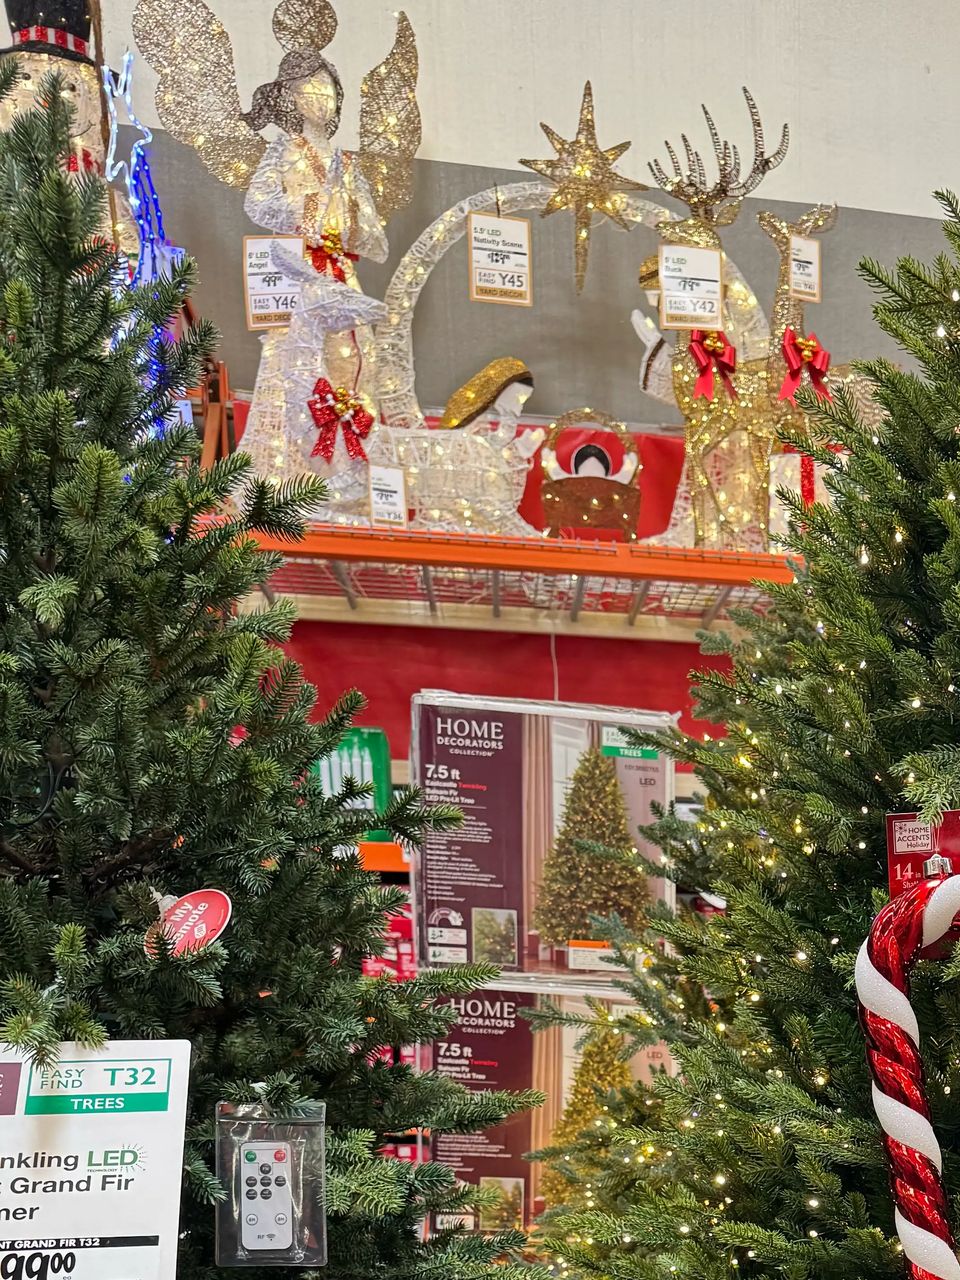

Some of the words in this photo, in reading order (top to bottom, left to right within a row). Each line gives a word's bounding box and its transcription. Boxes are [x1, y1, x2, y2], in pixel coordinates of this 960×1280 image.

[498, 273, 524, 288] Y45
[273, 295, 297, 309] Y46
[690, 299, 716, 313] Y42
[436, 717, 504, 739] HOME
[436, 736, 503, 750] DECORATORS
[619, 749, 642, 757] TREES
[425, 764, 449, 779] 7.5
[450, 769, 460, 780] ft
[908, 826, 929, 834] HOME
[897, 834, 930, 842] ACCENTS
[894, 862, 914, 880] 14
[170, 902, 193, 921] My
[451, 998, 516, 1019] HOME
[456, 1017, 515, 1028] ECORATORS
[437, 1042, 461, 1056] 7.5
[462, 1047, 472, 1057] ft
[41, 1068, 85, 1080] EASY
[104, 1067, 156, 1086] T32
[40, 1079, 83, 1090] FIND
[70, 1097, 125, 1110] TREES
[87, 1149, 139, 1167] LED
[10, 1175, 91, 1194] Grand
[101, 1174, 135, 1191] Fir
[14, 1239, 56, 1249] GRAND
[60, 1238, 76, 1247] FIR
[80, 1238, 100, 1247] T32
